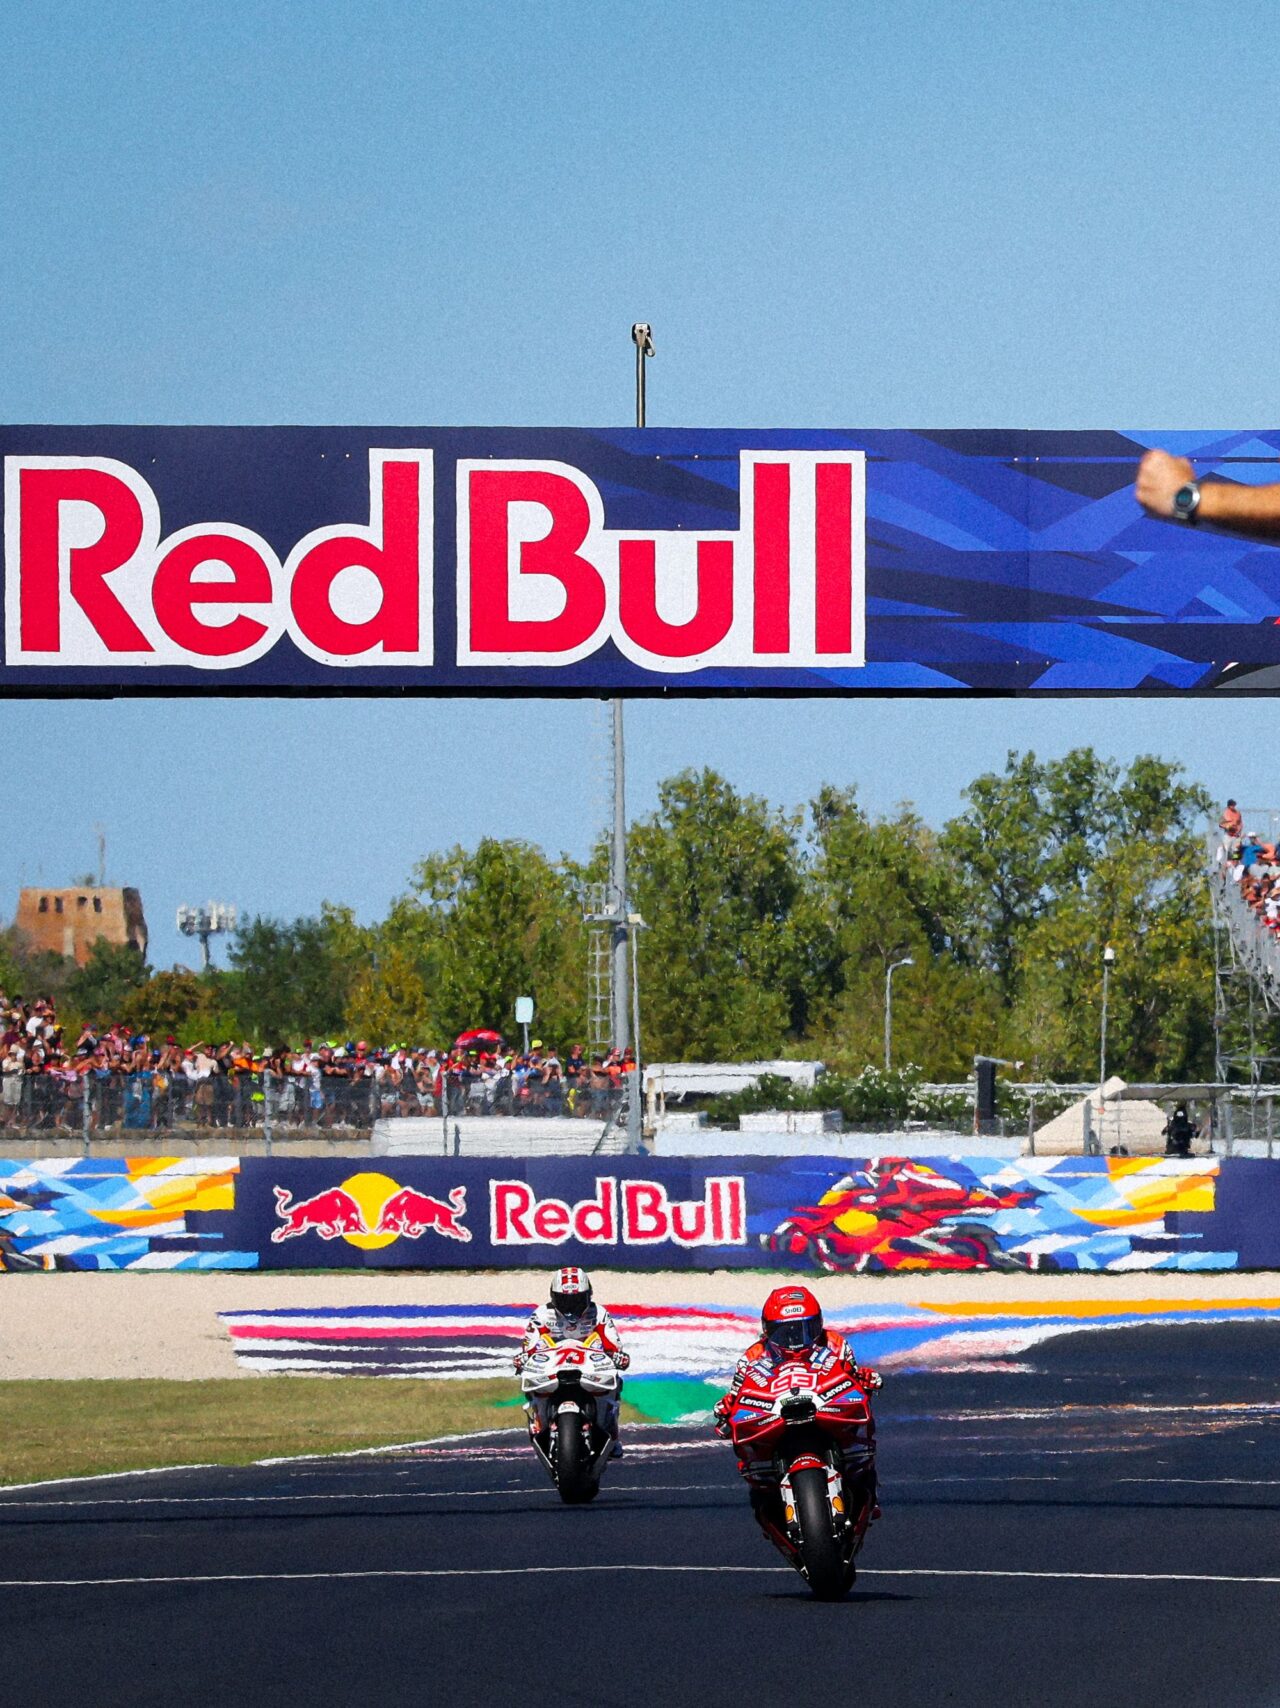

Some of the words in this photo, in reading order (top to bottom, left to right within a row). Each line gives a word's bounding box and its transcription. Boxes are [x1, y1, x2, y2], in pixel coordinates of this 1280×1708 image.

[5, 448, 433, 670] Red
[456, 449, 866, 673] Bull
[489, 1177, 617, 1245] Red
[621, 1176, 747, 1249] Bull
[556, 1348, 586, 1367] 73
[820, 1380, 853, 1400] Lenovo
[739, 1396, 773, 1409] Lenovo
